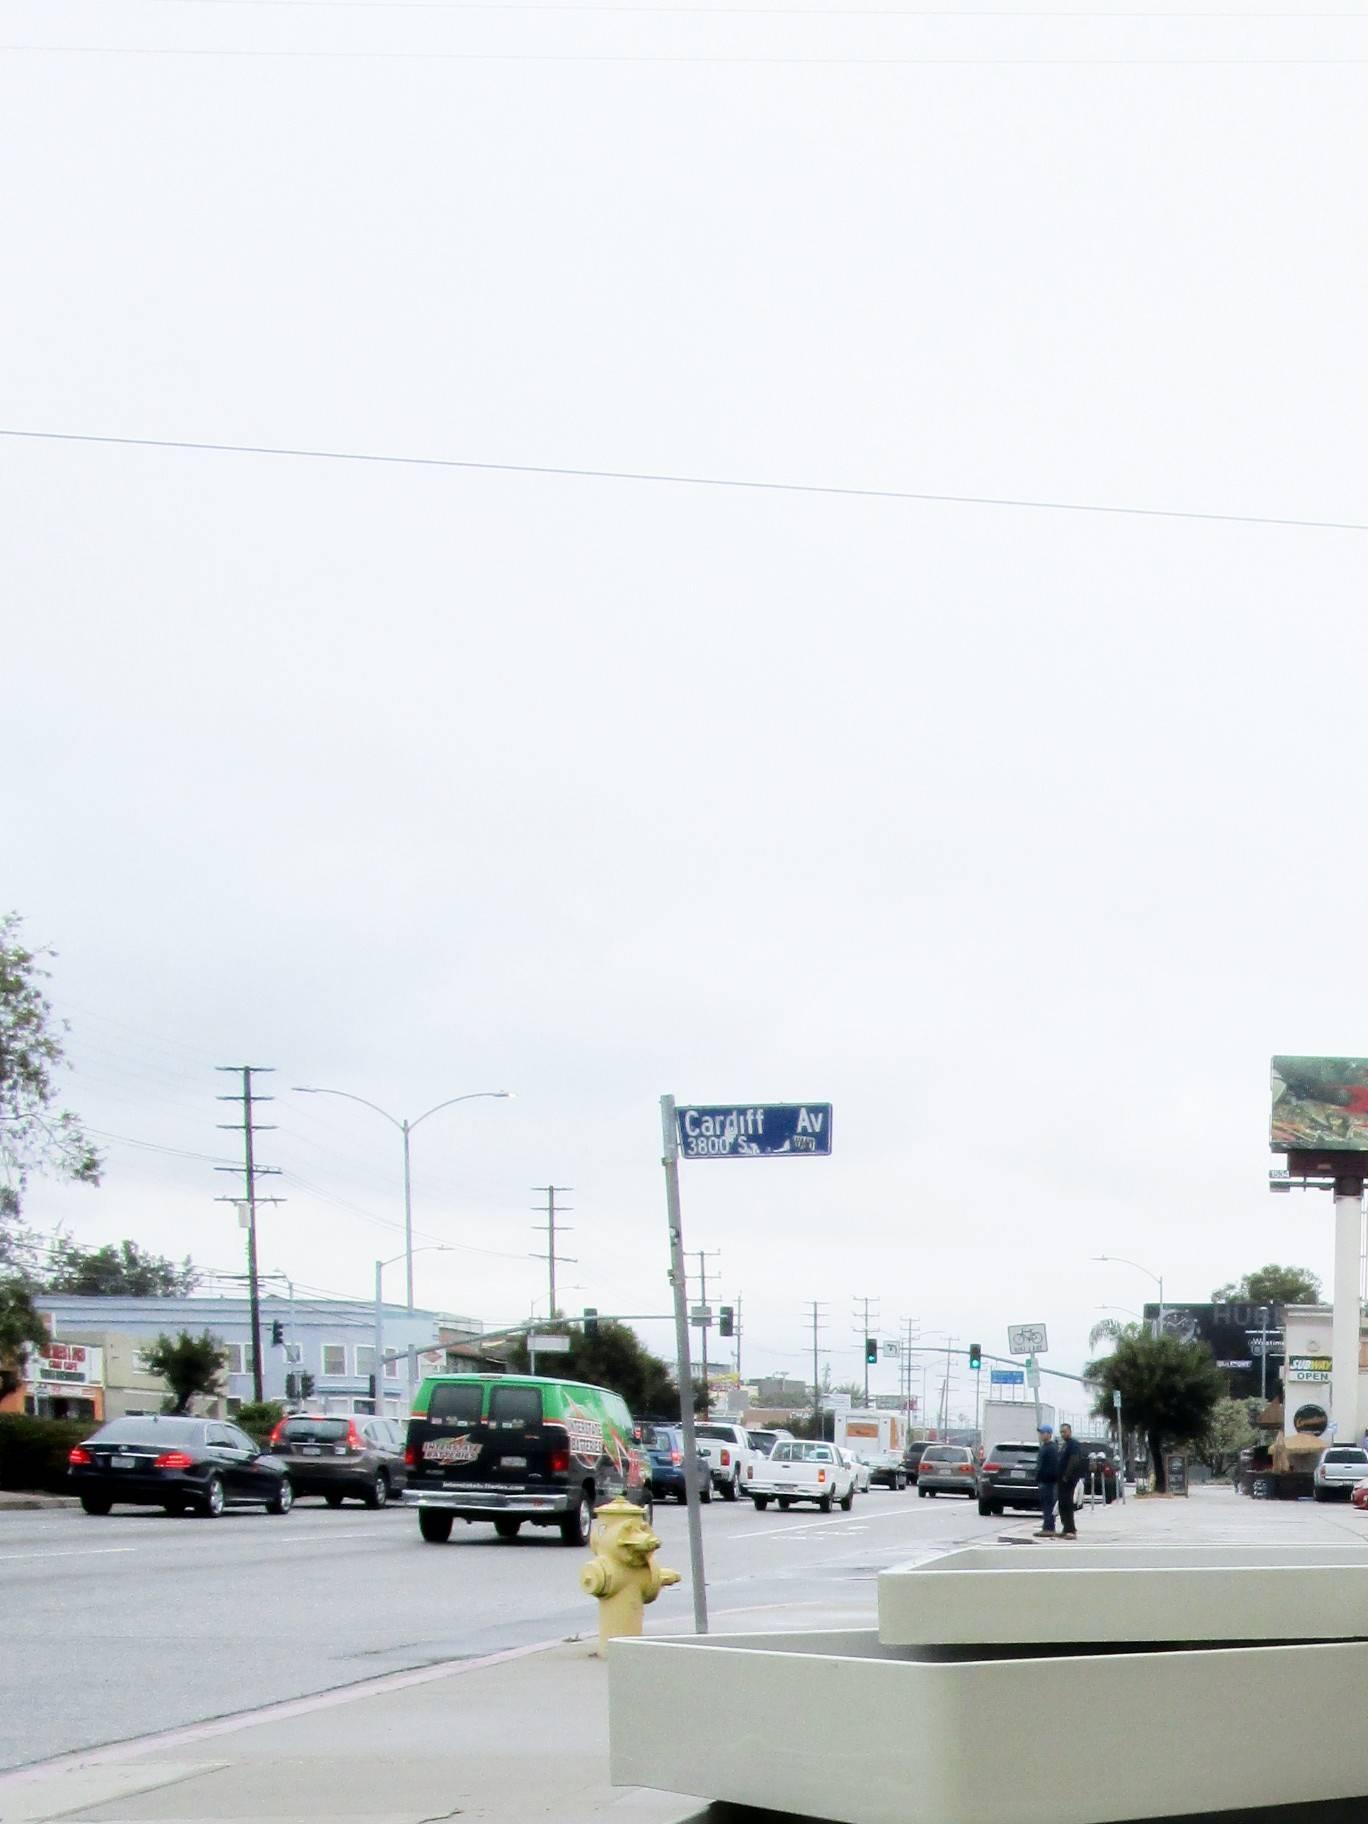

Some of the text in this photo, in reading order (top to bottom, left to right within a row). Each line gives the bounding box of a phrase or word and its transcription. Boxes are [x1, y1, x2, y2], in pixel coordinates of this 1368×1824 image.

[685, 1107, 823, 1137] Cardiff Av
[687, 1136, 748, 1155] 3800 S
[1290, 1359, 1332, 1370] SUBWAY
[1297, 1372, 1329, 1381] OPEN
